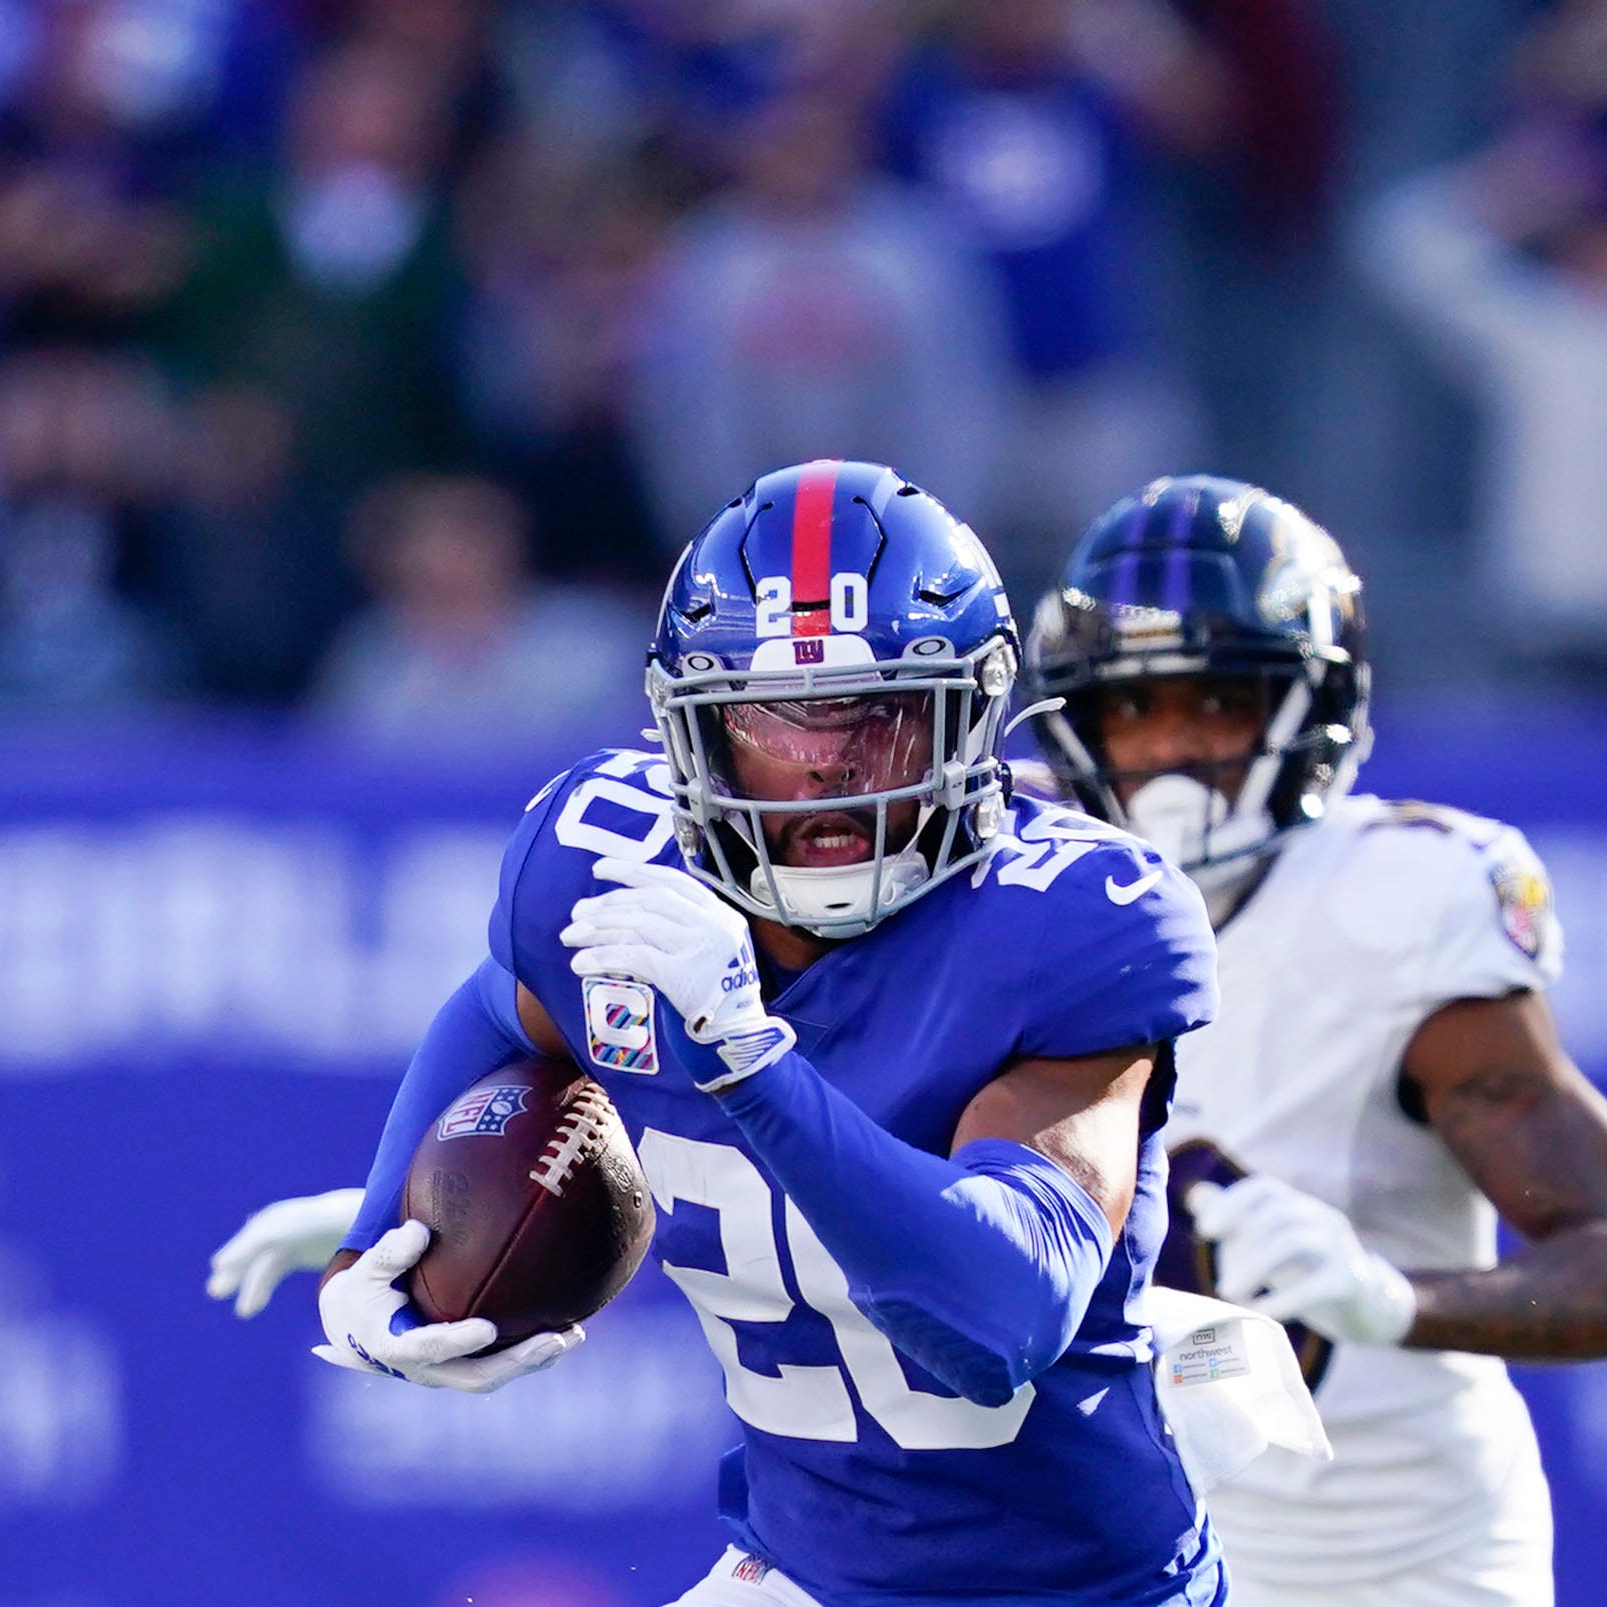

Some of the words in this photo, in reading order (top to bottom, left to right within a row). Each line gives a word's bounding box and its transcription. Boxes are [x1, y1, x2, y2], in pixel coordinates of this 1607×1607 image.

[756, 571, 868, 638] 20
[589, 984, 650, 1049] C
[445, 1090, 494, 1134] NFL
[1179, 1345, 1234, 1361] northwest
